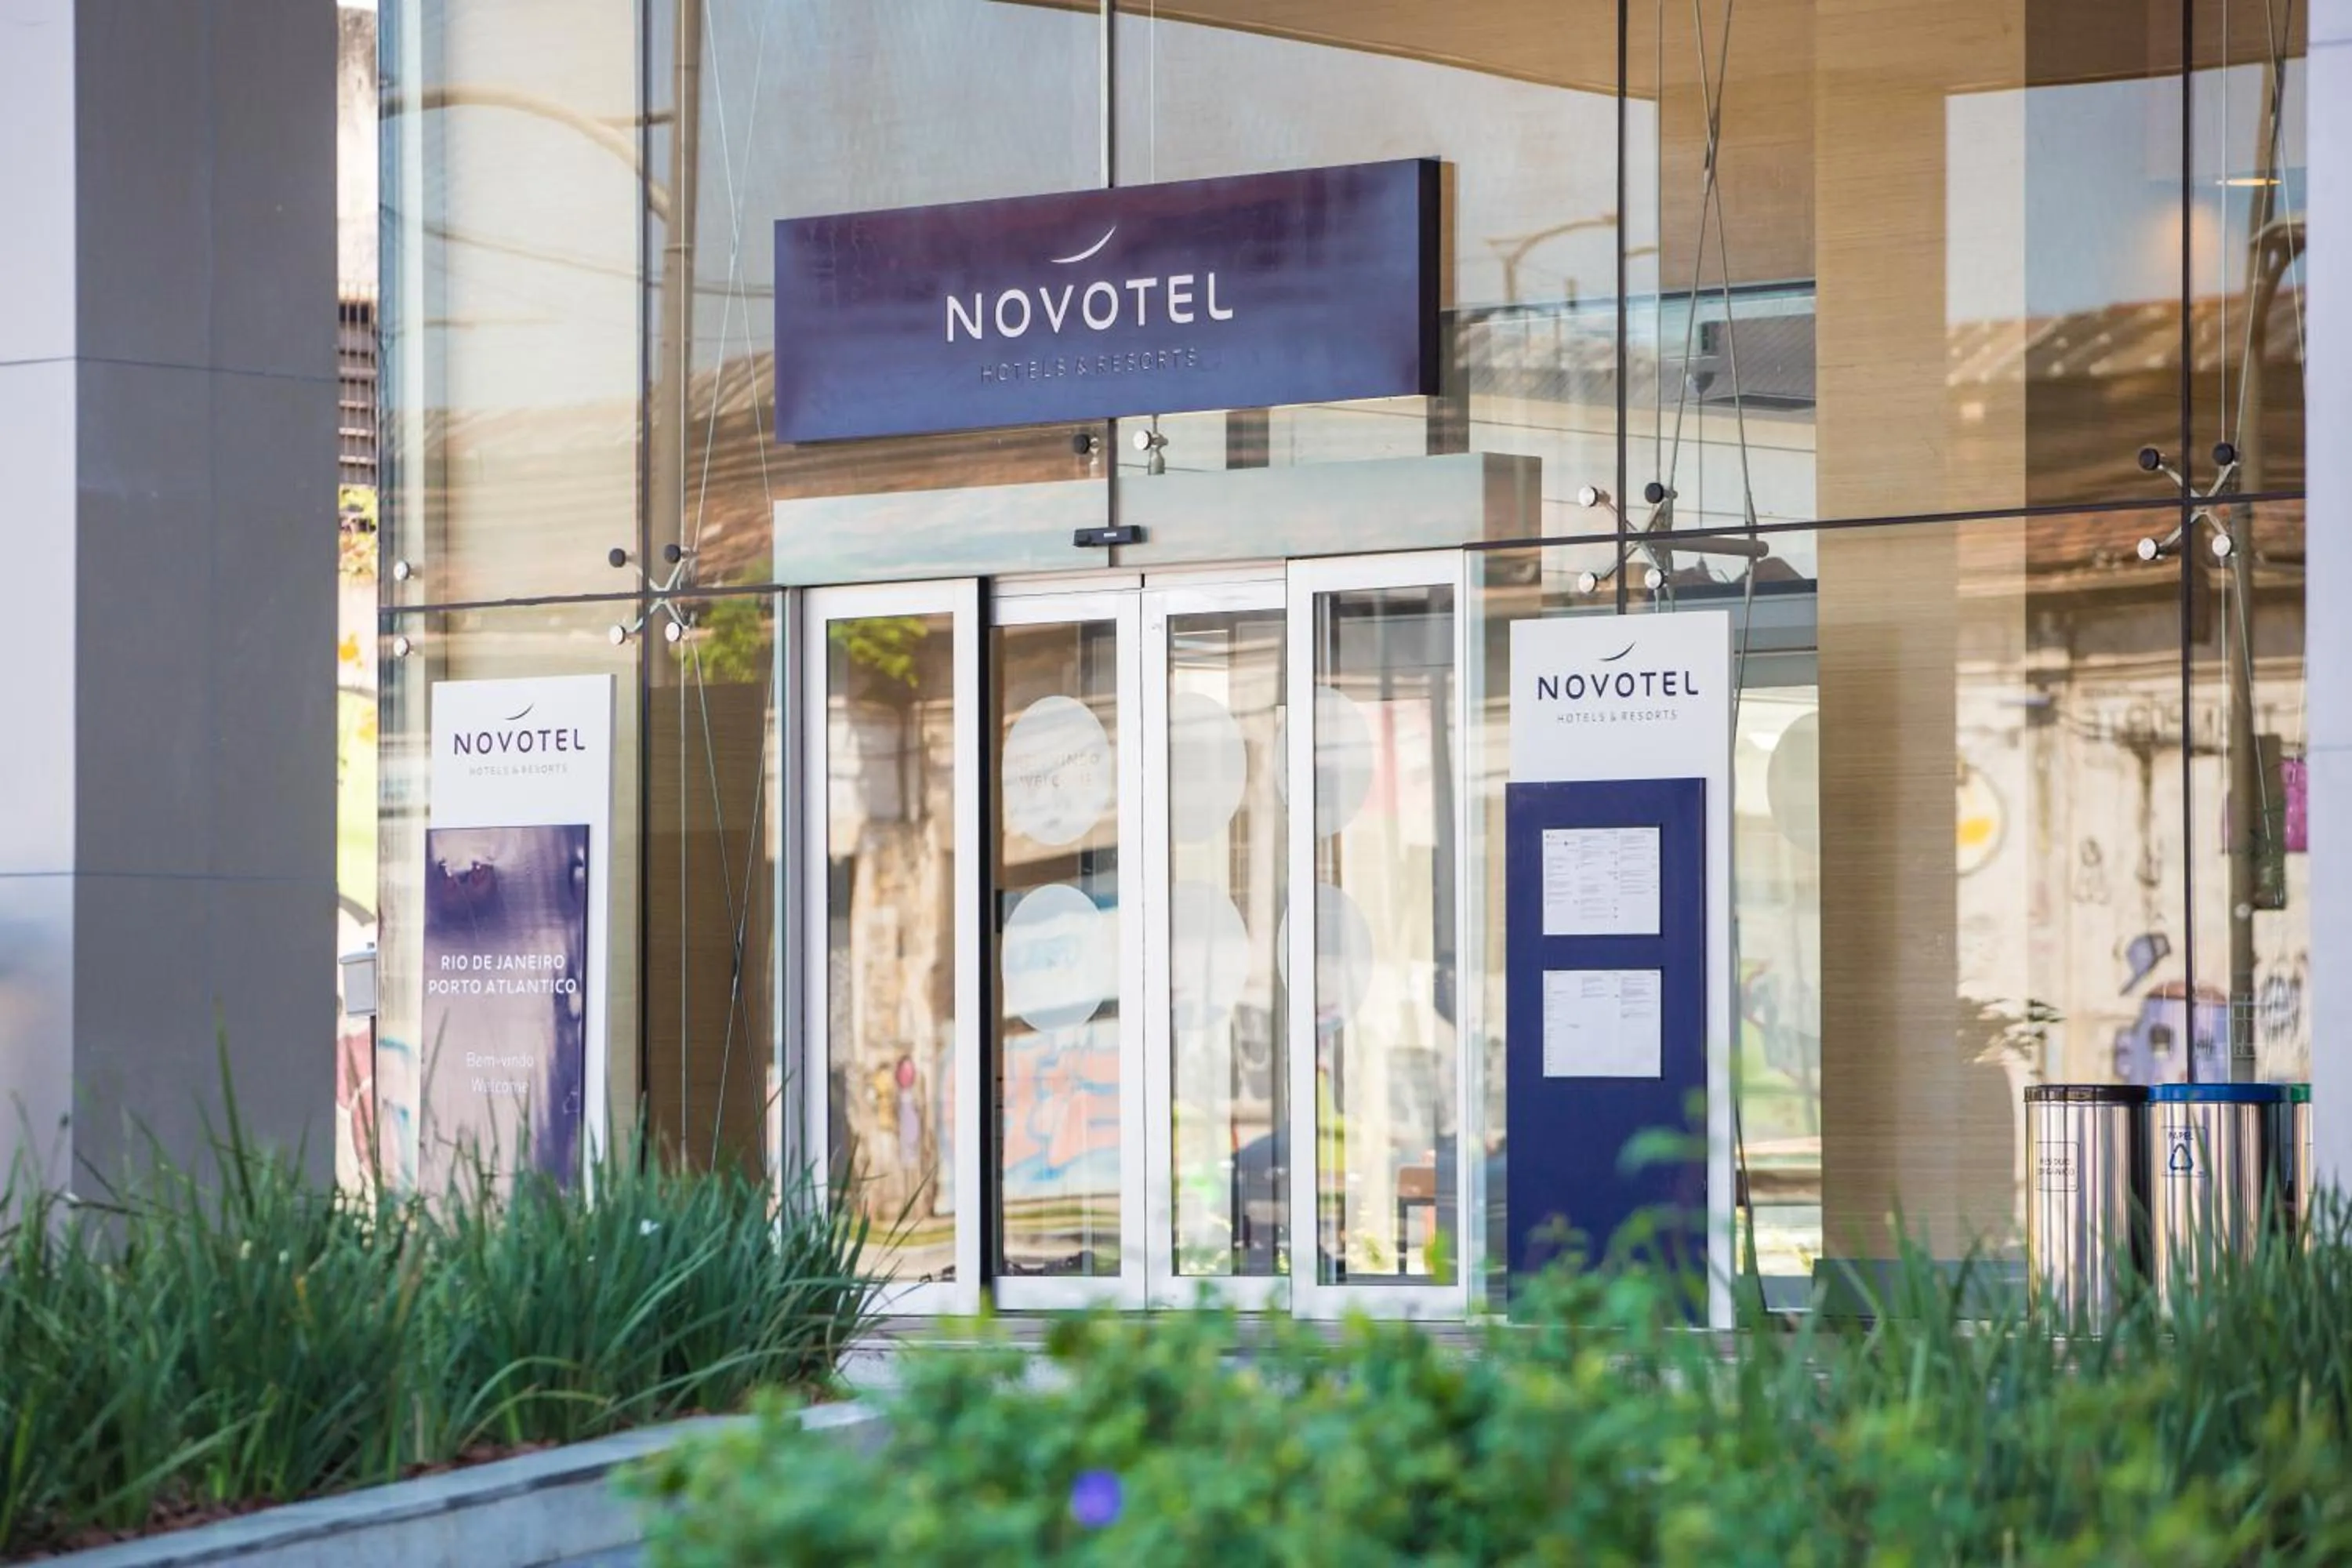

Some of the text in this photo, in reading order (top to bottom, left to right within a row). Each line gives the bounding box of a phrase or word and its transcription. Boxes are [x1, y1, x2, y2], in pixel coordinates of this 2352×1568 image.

[946, 271, 1233, 343] NOVOTEL
[980, 347, 1198, 383] HOTELS & RESORTS
[1537, 670, 1699, 701] NOVOTEL
[1557, 711, 1606, 724] HOTELS
[1621, 709, 1678, 721] RESORTS
[453, 728, 586, 756] NOVOTEL
[441, 953, 566, 971] RIO DE JANEIRO
[427, 978, 577, 995] PORTO ATLANTICO
